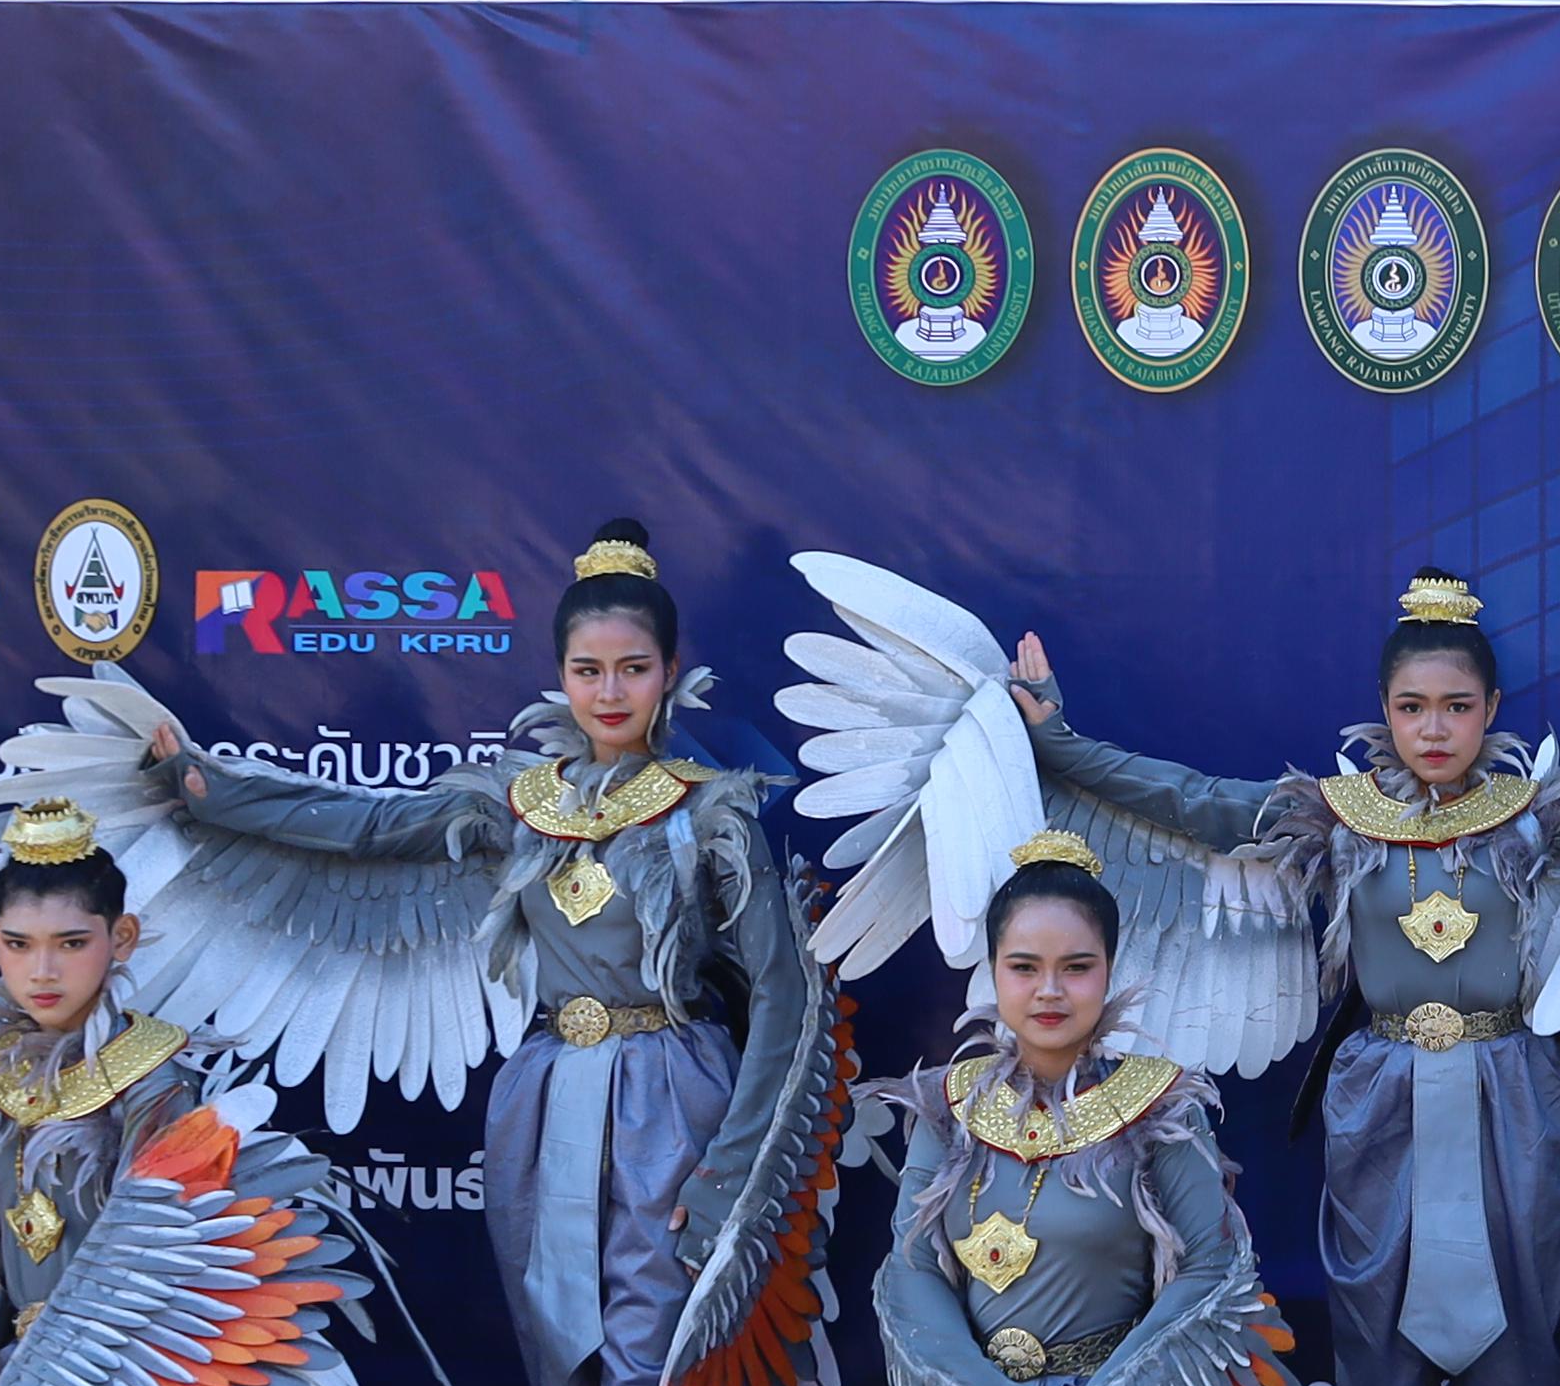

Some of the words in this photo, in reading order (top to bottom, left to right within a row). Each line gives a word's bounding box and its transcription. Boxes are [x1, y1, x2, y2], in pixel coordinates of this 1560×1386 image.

[858, 282, 881, 334] CHIANG
[876, 336, 898, 360] MAI
[903, 362, 979, 382] RAJABHAT
[982, 284, 1028, 361] UNIVERSITY
[1080, 296, 1106, 345] CHIANG
[1105, 345, 1125, 367] RAI
[1125, 363, 1190, 382] RAJABHAT
[1194, 297, 1241, 368] UNIVERSITY
[1310, 290, 1347, 357] LAMPANG
[1345, 355, 1423, 383] RAJABHAT
[1426, 293, 1478, 369] UNIVERSITY
[195, 570, 516, 654] RASSA
[294, 633, 375, 653] EDU
[400, 633, 511, 654] KPRU
